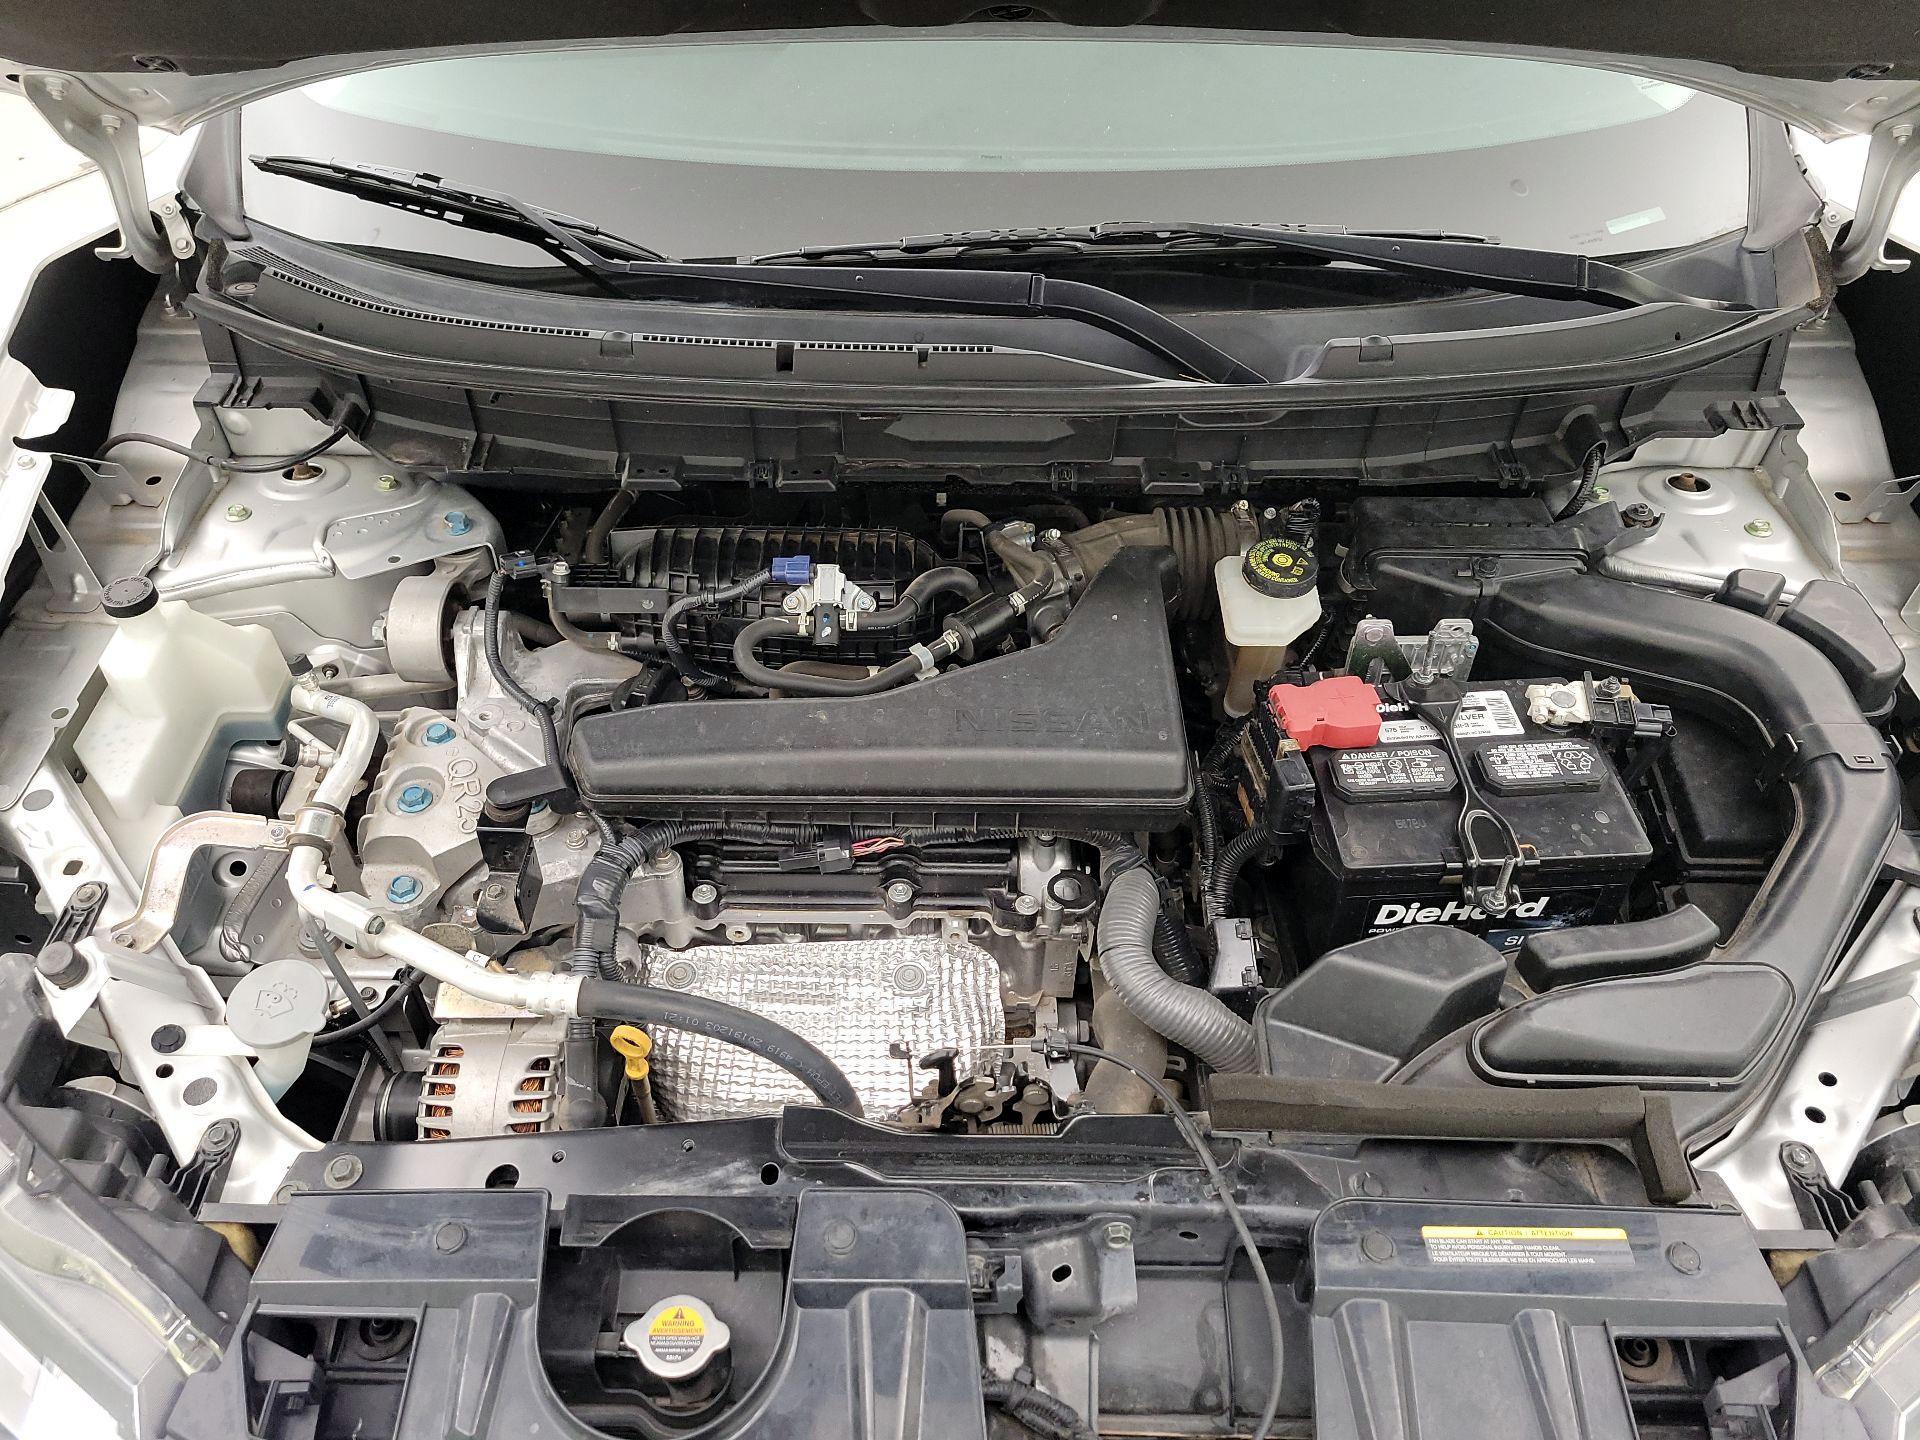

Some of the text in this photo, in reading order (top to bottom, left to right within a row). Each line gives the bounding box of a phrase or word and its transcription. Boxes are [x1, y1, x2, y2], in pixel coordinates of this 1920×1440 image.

[953, 709, 1149, 732] NISSAN
[1459, 713, 1485, 721] ILVER
[1350, 751, 1389, 759] DANGER
[1397, 749, 1432, 757] POISON
[664, 1011, 700, 1026] 01:21
[705, 1021, 763, 1048] 20191203
